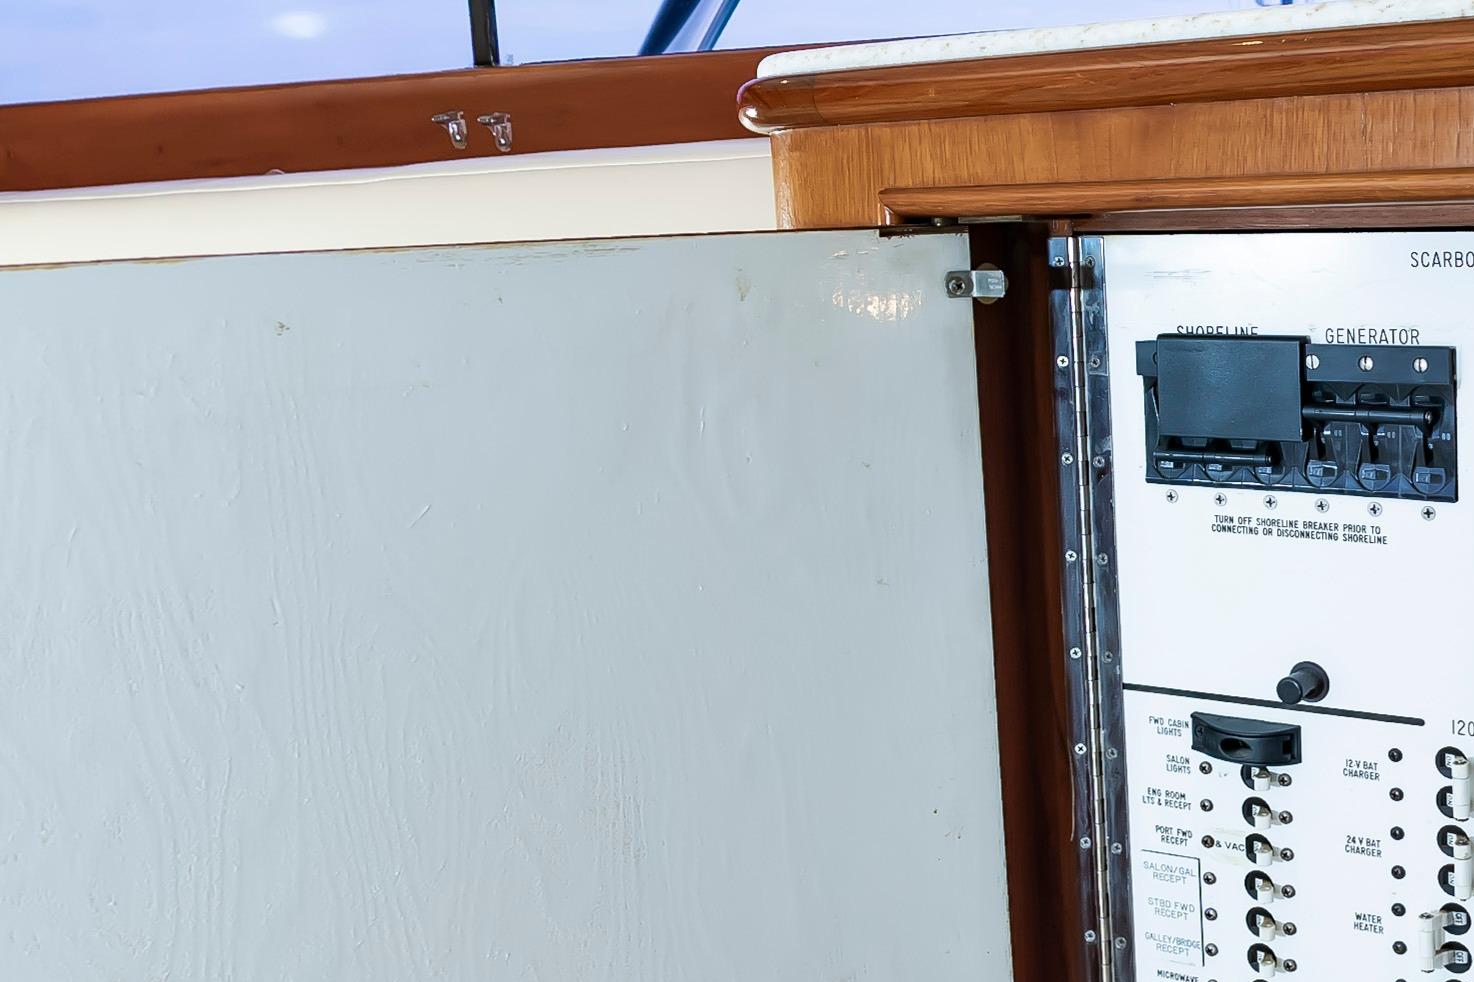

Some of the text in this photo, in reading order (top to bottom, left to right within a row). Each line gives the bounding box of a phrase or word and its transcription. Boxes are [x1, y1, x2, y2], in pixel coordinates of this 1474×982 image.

[1326, 328, 1419, 344] GENERATOR
[1215, 515, 1380, 534] TURN OFF SHORELINE BREAKER PRIOR TO
[1212, 524, 1387, 544] CONNECTING OR DISCONNECTING SHORELINE
[1149, 716, 1189, 728] FWD CABIN
[1157, 726, 1182, 737] LIGHTS
[1166, 755, 1190, 764] SALON
[1166, 763, 1191, 774] LIGHTS
[1343, 768, 1380, 781] CHARGER
[1148, 787, 1186, 800] ENG ROOM
[1156, 825, 1192, 838] PORT FWD
[1161, 835, 1188, 846] RECEPT
[1345, 845, 1382, 857] CHARGER
[1153, 872, 1186, 885] RECEPT
[1155, 907, 1188, 920] RECEPT
[1355, 912, 1382, 924] WATER
[1354, 922, 1383, 934] HEATER
[1156, 943, 1189, 956] RECEPT
